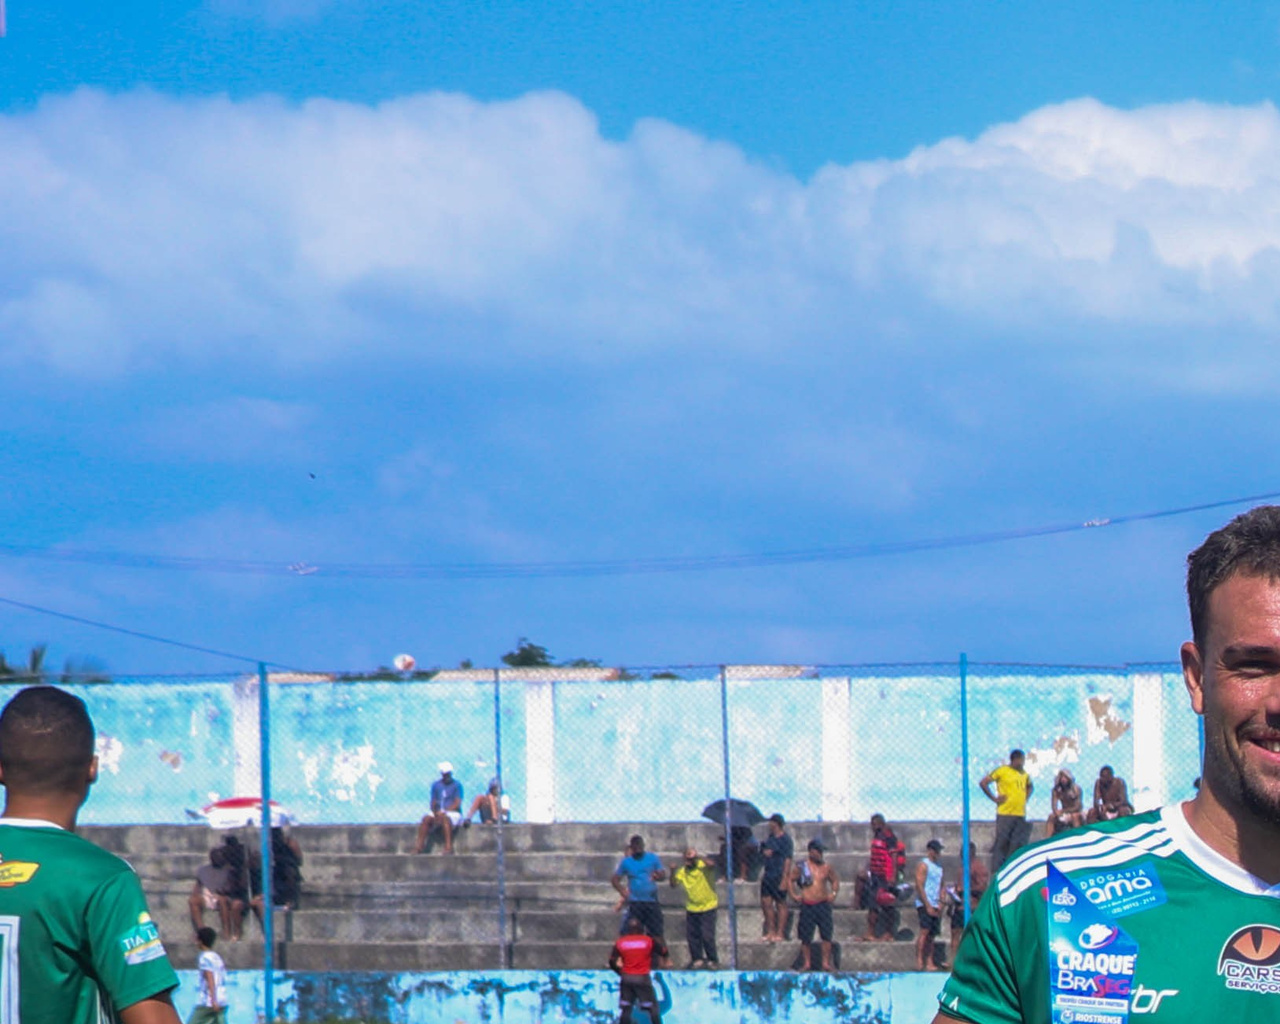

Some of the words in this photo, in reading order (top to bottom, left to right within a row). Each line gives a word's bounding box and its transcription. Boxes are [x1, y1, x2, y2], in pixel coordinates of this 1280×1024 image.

[1079, 868, 1146, 891] DROGARIA
[1085, 876, 1152, 905] ama
[1057, 951, 1135, 976] CRAQUE
